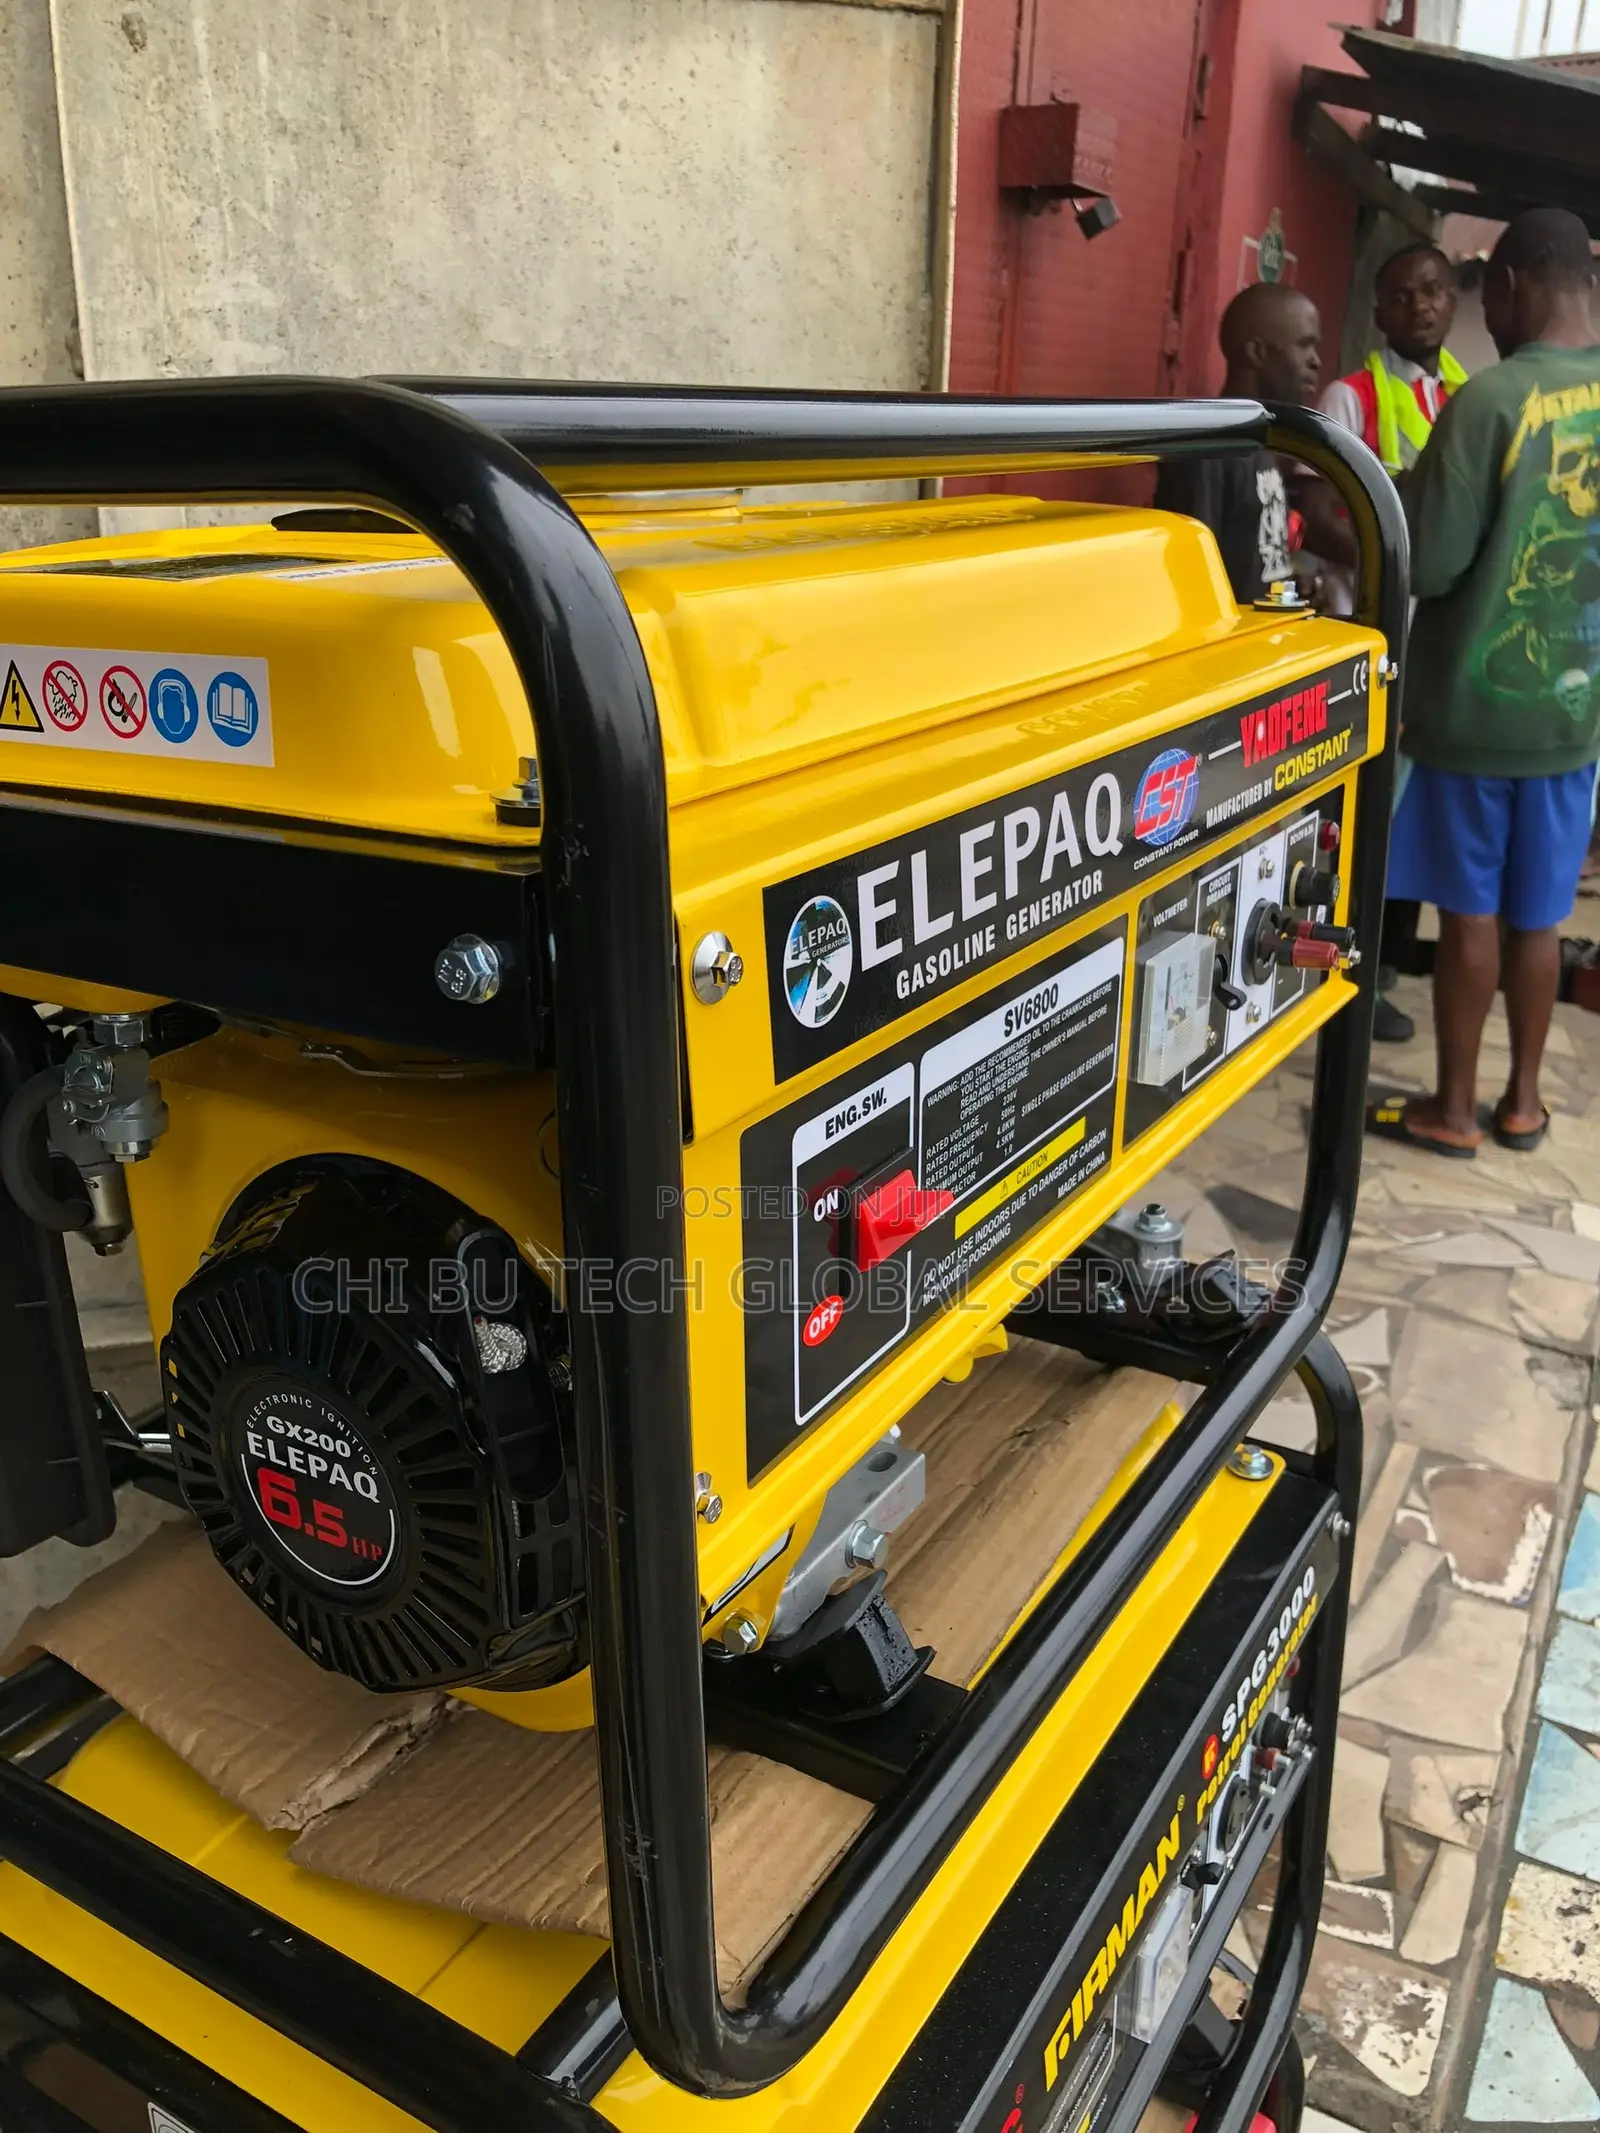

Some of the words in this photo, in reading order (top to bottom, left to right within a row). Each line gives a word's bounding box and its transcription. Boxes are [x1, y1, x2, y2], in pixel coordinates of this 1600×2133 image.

[1240, 681, 1328, 769] YAOFENG
[1135, 755, 1198, 840] CST
[1206, 783, 1262, 829] MANUFACTURED
[1264, 777, 1272, 798] BY
[1275, 728, 1351, 791] CONSTANT
[857, 772, 1123, 972] ELEPAQ
[1133, 843, 1173, 870] CONSTANT
[1173, 829, 1198, 848] POWER
[791, 917, 848, 960] ELEPAQ
[896, 924, 996, 999] GASOLINE
[1006, 870, 1103, 940] GENERATOR
[1153, 897, 1188, 927] VOLTMETER
[927, 1080, 959, 1107] WARNING:
[960, 1071, 973, 1086] ADD
[975, 1062, 986, 1075] THE
[987, 1034, 1031, 1070] RECOMMENDED
[1032, 1027, 1041, 1040] OIL
[1042, 1022, 1050, 1033] TO
[1051, 1014, 1061, 1028] THE
[1061, 994, 1092, 1021] CRANKCASE
[1093, 981, 1112, 1002] BEFORE
[1004, 982, 1058, 1037] SV6800
[961, 1091, 977, 1109] READ
[978, 1082, 991, 1097] AND
[992, 1056, 1029, 1087] UNDERSTAND
[1030, 1048, 1041, 1062] THE
[1066, 1018, 1087, 1038] MANUAL
[1088, 1004, 1107, 1025] BEFORE
[961, 1081, 974, 1097] YOU
[975, 1068, 994, 1088] START
[995, 1060, 1006, 1075] THE
[1021, 1094, 1041, 1117] SINGLE
[1042, 1081, 1059, 1102] PHASE
[1060, 1063, 1085, 1089] GASOLINE
[1086, 1043, 1113, 1071] GENERATOR
[825, 1087, 887, 1140] ENG.SW.
[926, 1137, 949, 1159] RATED
[949, 1115, 979, 1142] VOLTAGE
[1003, 1088, 1017, 1106] 230V
[960, 1091, 994, 1120] OPERATING
[995, 1082, 1006, 1096] THE
[925, 1165, 949, 1188] RATED
[949, 1145, 975, 1170] OUTPUT
[997, 1115, 1016, 1136] 4.0KW
[926, 1151, 949, 1174] RATED
[949, 1122, 989, 1157] FREQUENCY
[958, 1152, 984, 1177] OUTPUT
[996, 1129, 1015, 1149] 4.5KW
[1004, 1144, 1013, 1156] 1.0
[1017, 1151, 1048, 1184] CAUTION
[1058, 1174, 1077, 1199] MADE
[1078, 1167, 1085, 1182] IN
[1086, 1151, 1105, 1175] CHINA
[814, 1189, 838, 1222] ON
[924, 1268, 936, 1288] DO
[938, 1250, 956, 1275] NOT
[957, 1236, 973, 1258] USE
[975, 1207, 1010, 1244] INDOORS
[1011, 1192, 1027, 1214] DUE
[1028, 1184, 1038, 1200] TO
[1039, 1159, 1068, 1192] DANGER
[1069, 1150, 1079, 1166] OF
[1079, 1128, 1107, 1158] CARBON
[923, 1259, 967, 1306] MONOXIDE
[968, 1223, 1011, 1267] POISONING
[809, 1302, 838, 1337] OFF
[246, 1393, 312, 1429] ELECTRONIC
[266, 1416, 351, 1458] GX200
[321, 1407, 378, 1476] IGNITION
[246, 1430, 380, 1504] ELEPAQ
[257, 1467, 348, 1548] 6.5
[352, 1535, 383, 1562] HP
[1222, 1565, 1315, 1743] SPG3000
[1044, 1812, 1180, 2092] FIRMAN
